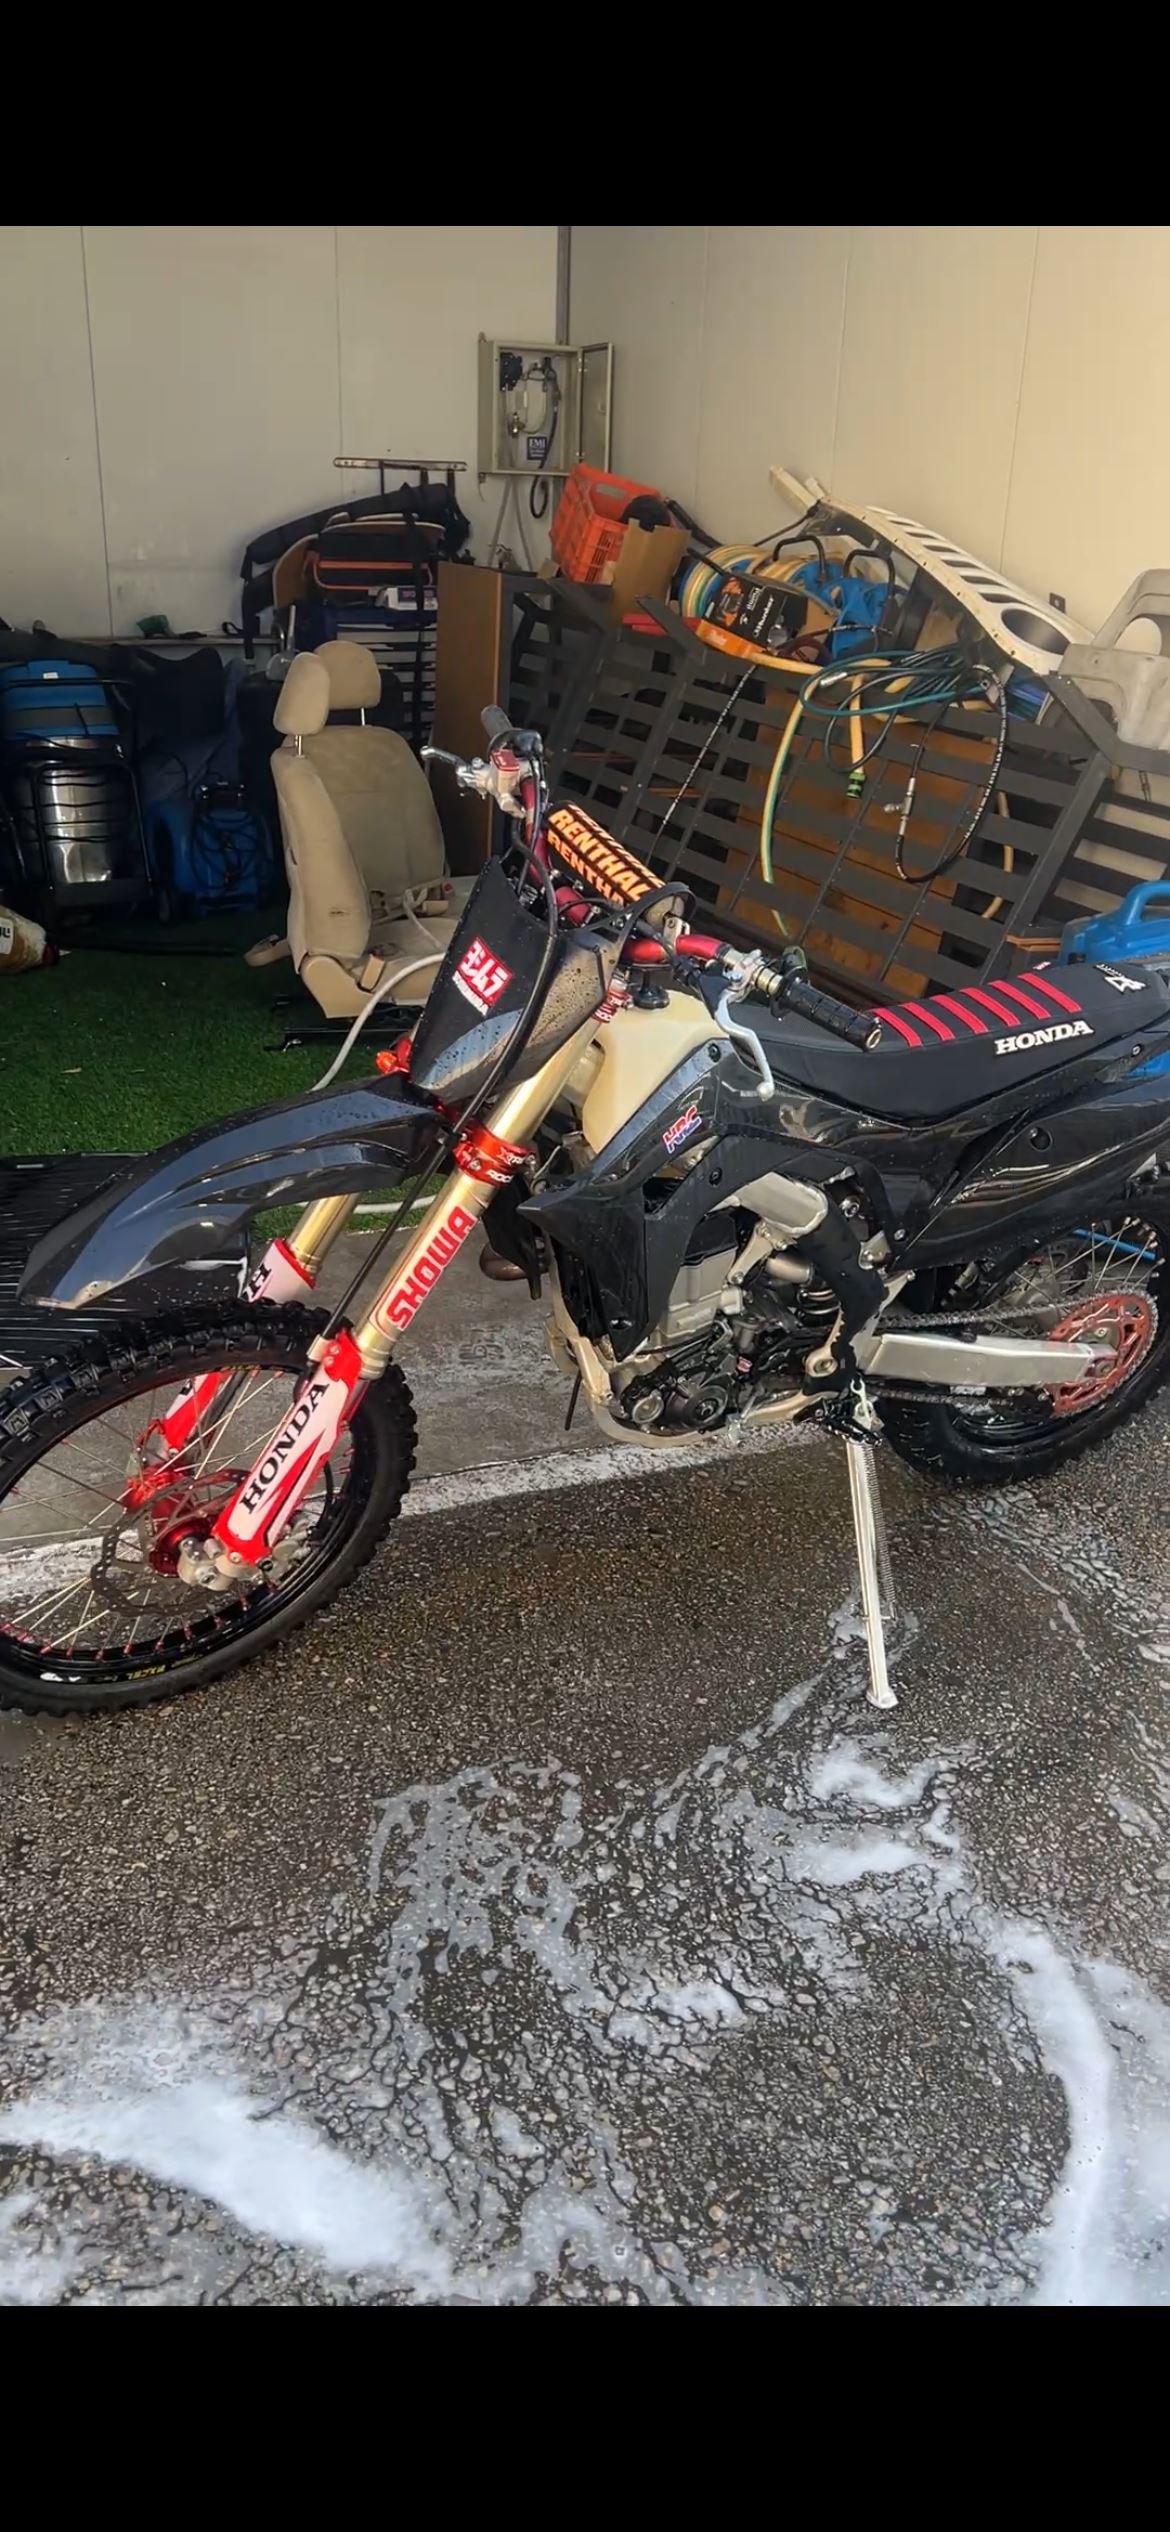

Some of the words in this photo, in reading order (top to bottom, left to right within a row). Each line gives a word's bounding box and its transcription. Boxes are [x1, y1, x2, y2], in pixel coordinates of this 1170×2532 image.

[547, 829, 626, 908] RENTHA
[548, 808, 652, 902] RENTHAL
[994, 1020, 1094, 1055] HONDA
[386, 1205, 477, 1330] SHOWA
[239, 1383, 330, 1514] HONDA
